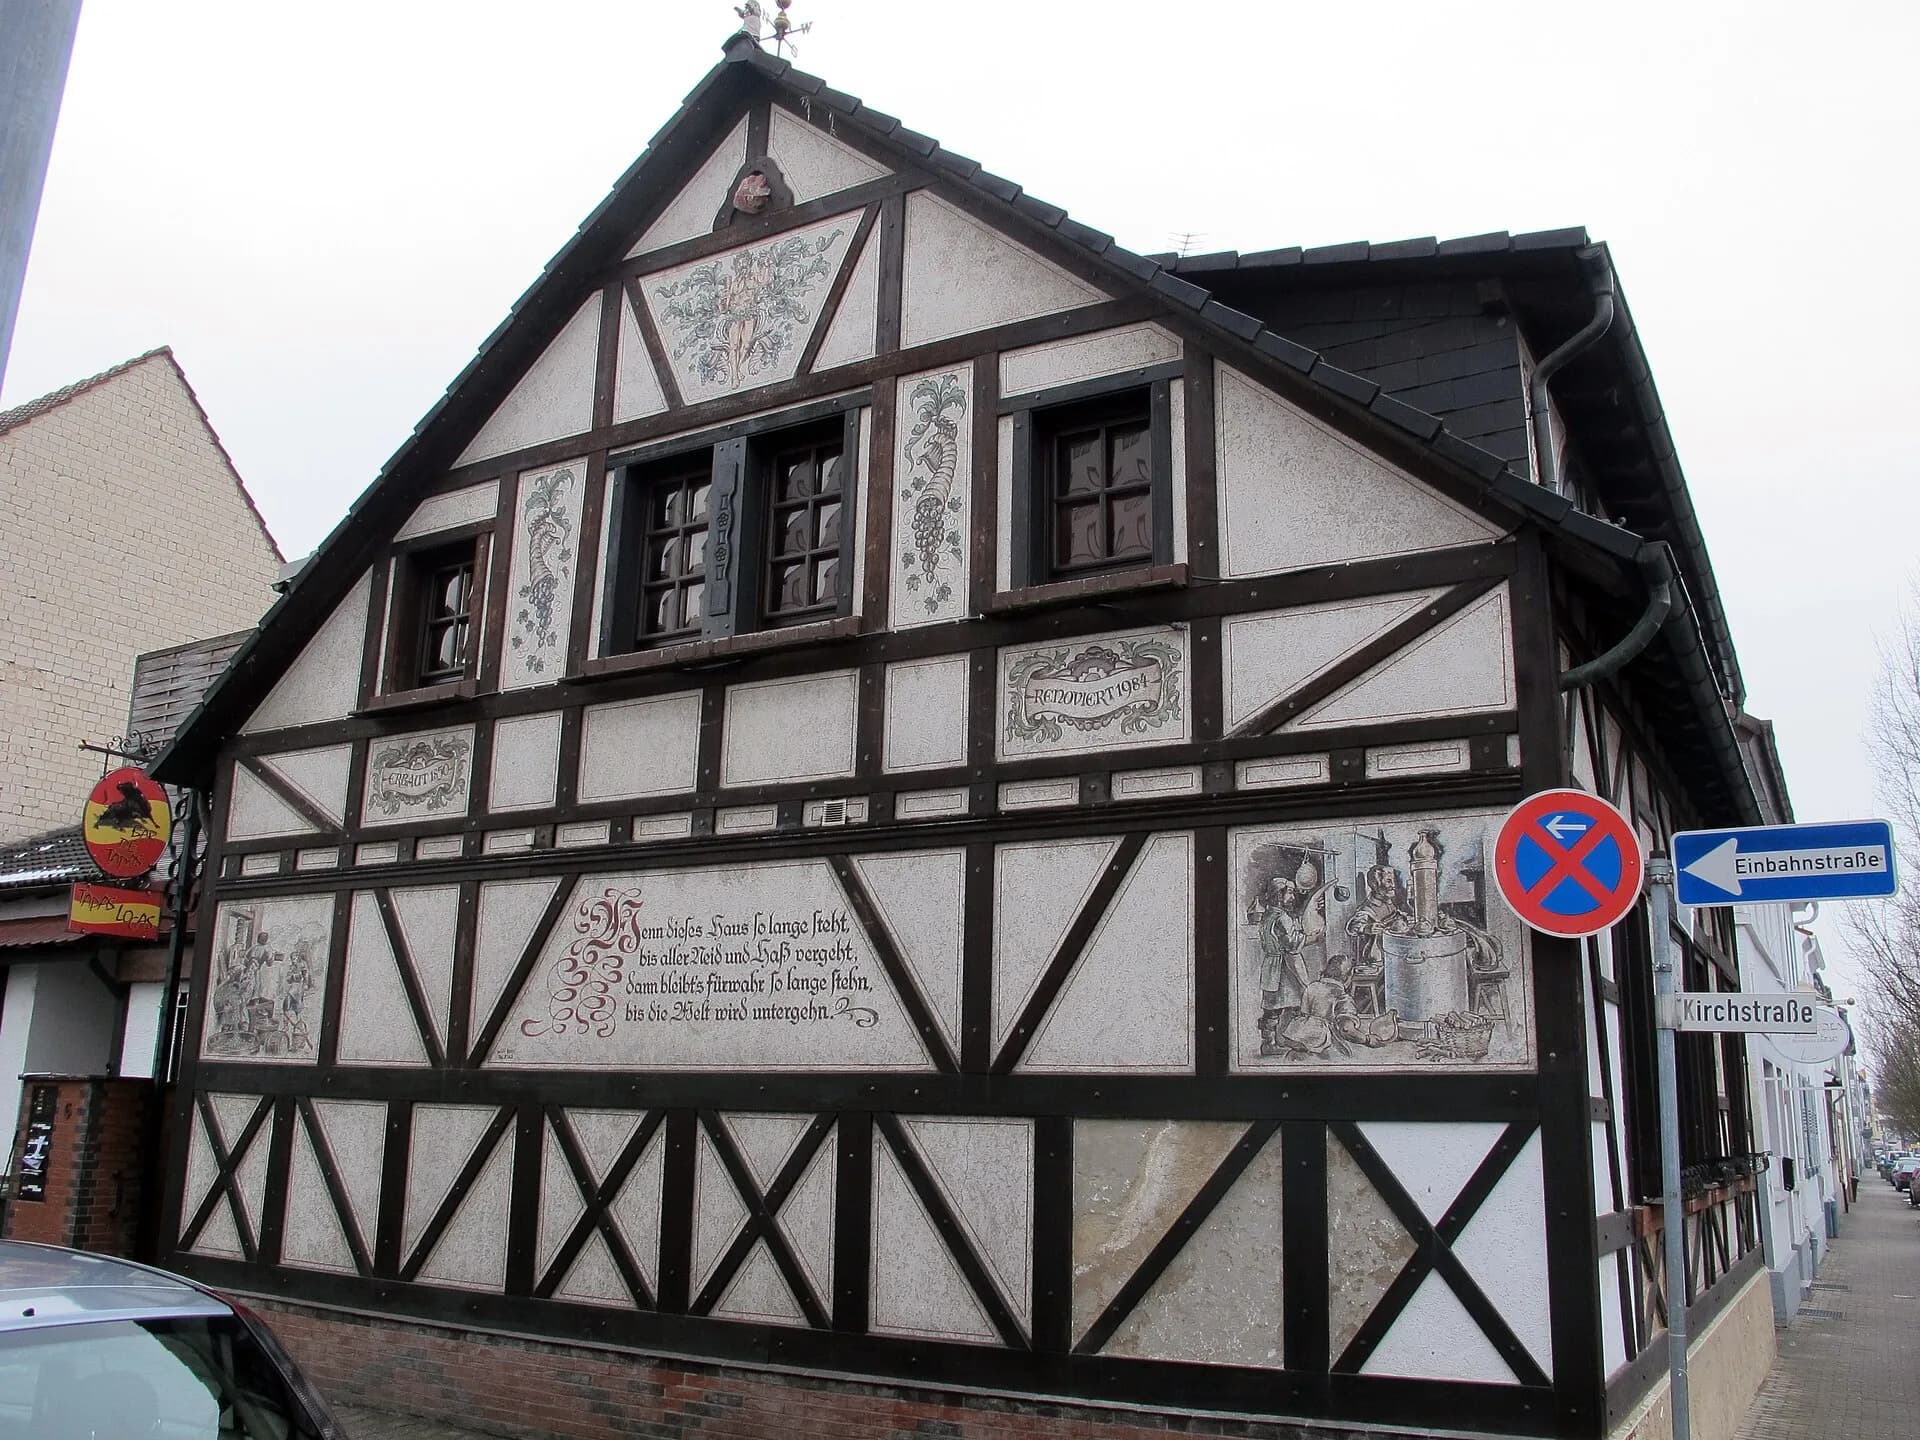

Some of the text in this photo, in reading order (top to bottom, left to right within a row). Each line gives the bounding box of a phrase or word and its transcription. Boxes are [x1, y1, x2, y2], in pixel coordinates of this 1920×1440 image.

[1033, 672, 1150, 707] RENOVIERT 1984
[1735, 851, 1879, 875] Einbahnstraße
[78, 888, 116, 911] TAPAS
[706, 914, 749, 940] Haus
[768, 910, 808, 939] lange
[639, 944, 658, 967] bis
[660, 943, 690, 966] aller
[725, 941, 750, 964] und
[786, 965, 828, 996] lange
[624, 999, 645, 1021] bis
[648, 1000, 668, 1021] die
[670, 1000, 711, 1023] Welt
[714, 997, 748, 1021] wird
[1683, 998, 1813, 1024] Kirchstraße
